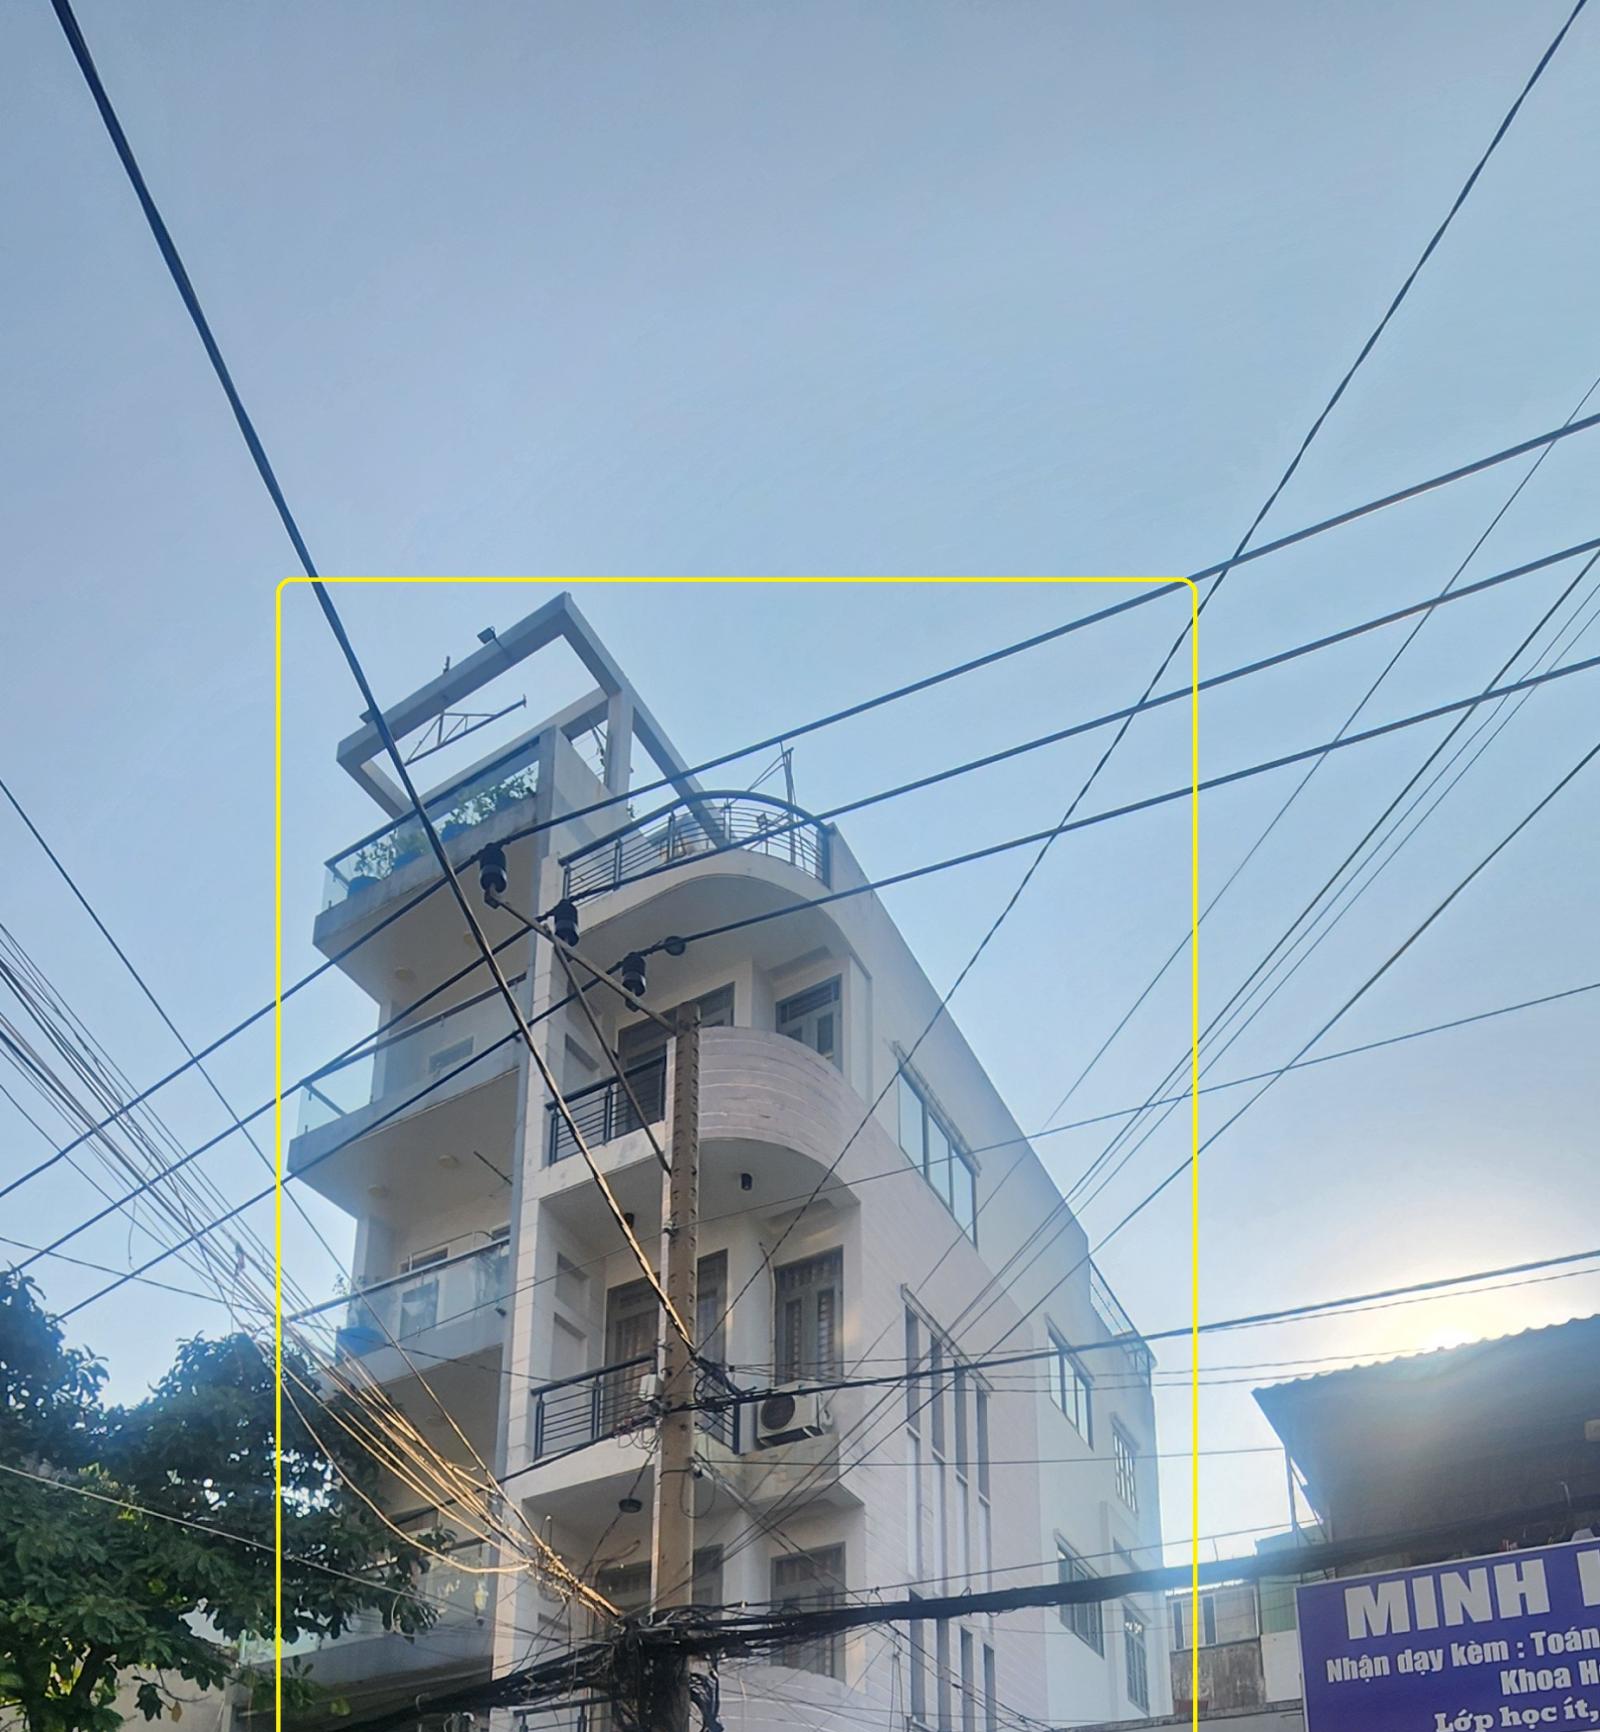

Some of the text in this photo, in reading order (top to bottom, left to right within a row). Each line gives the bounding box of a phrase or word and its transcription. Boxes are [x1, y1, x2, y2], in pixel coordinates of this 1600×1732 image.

[1344, 1558, 1551, 1640] MINH
[1326, 1655, 1391, 1683] Nhận
[1397, 1649, 1443, 1676] dạy
[1451, 1640, 1509, 1667] kèm
[1530, 1626, 1600, 1657] Toán
[1500, 1659, 1600, 1696] Khoa H
[1499, 1706, 1558, 1730] học
[1563, 1696, 1599, 1723] ít,
